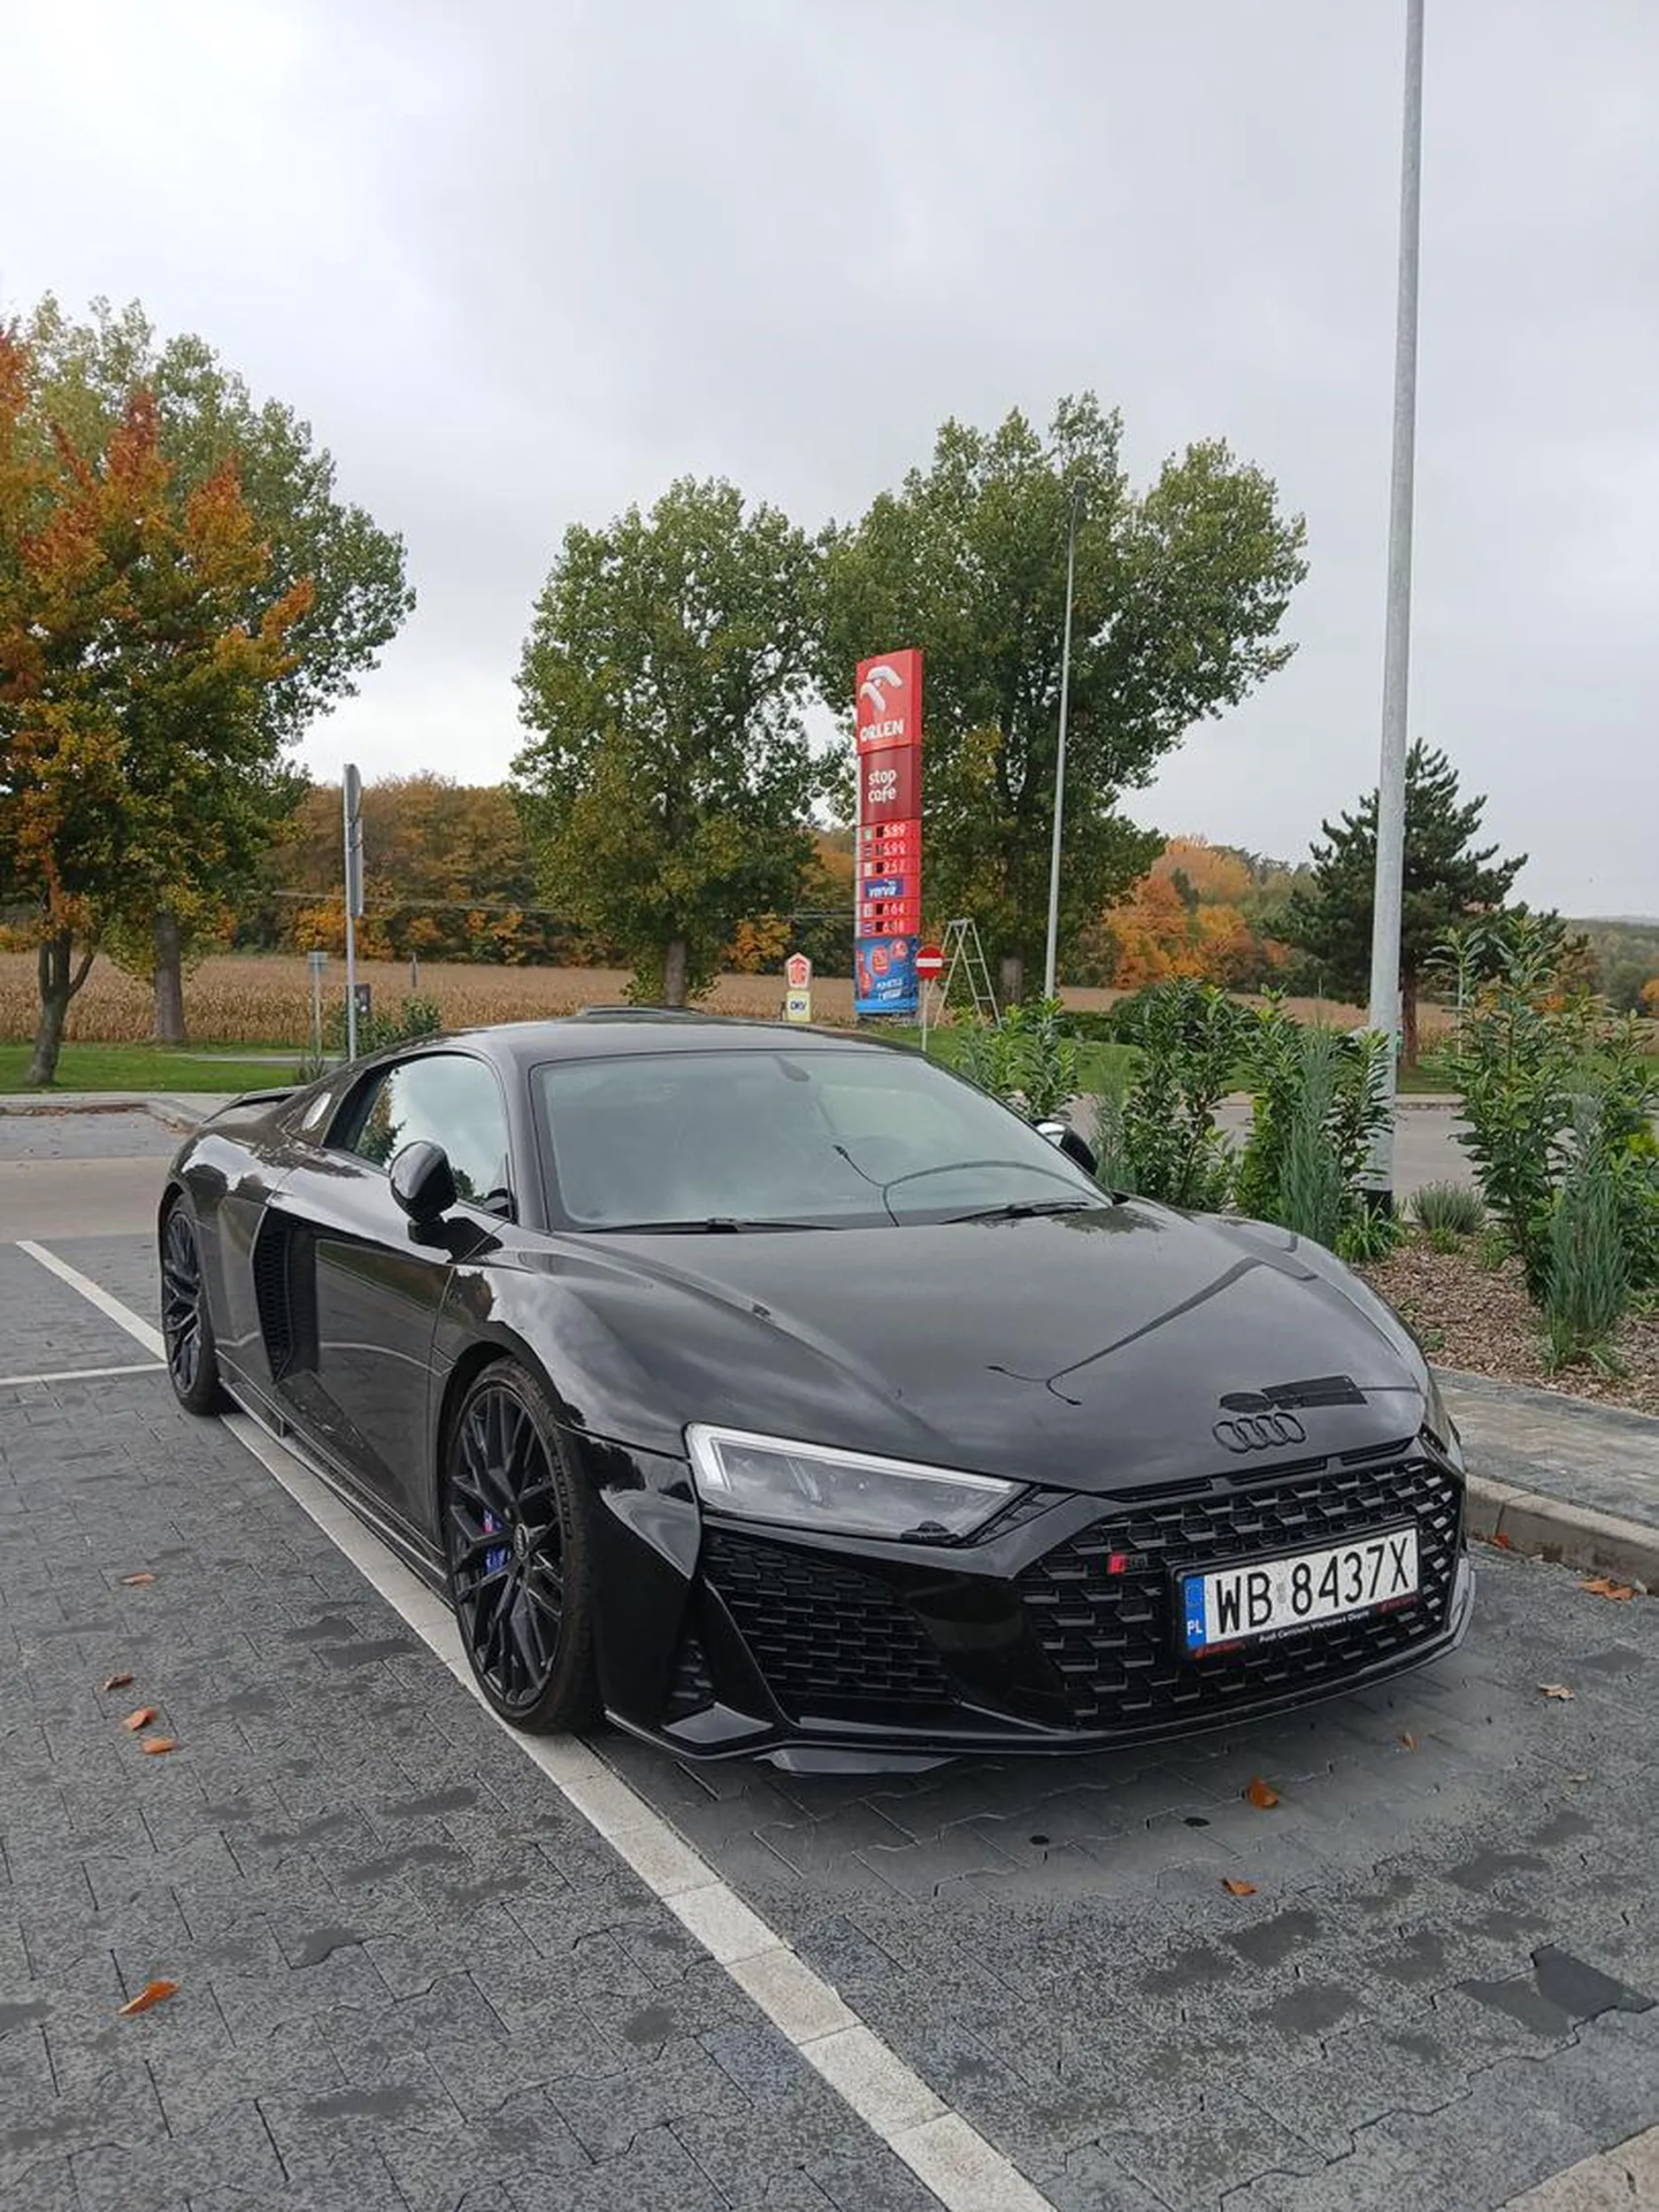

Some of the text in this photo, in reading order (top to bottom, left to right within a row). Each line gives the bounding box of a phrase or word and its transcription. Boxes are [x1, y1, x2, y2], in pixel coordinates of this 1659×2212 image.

[859, 718, 904, 741] ORLEN
[869, 769, 896, 787] stop
[1216, 1538, 1409, 1634] WB 8437X
[1187, 1619, 1203, 1637] PL
